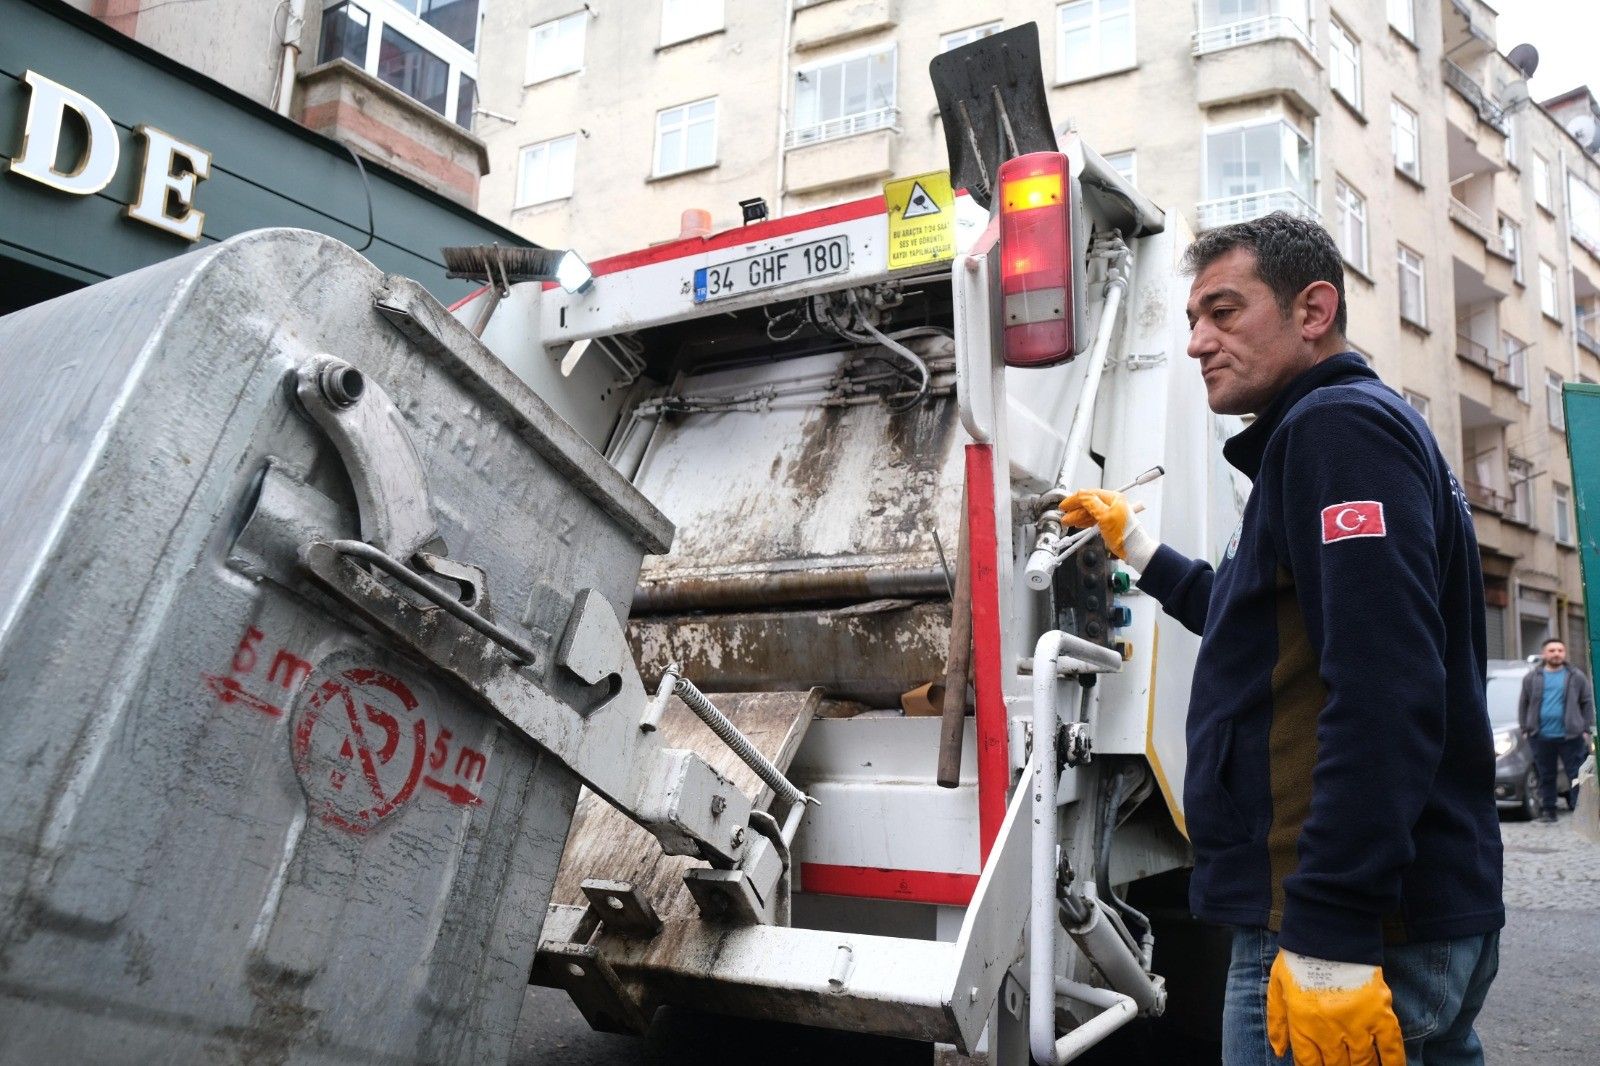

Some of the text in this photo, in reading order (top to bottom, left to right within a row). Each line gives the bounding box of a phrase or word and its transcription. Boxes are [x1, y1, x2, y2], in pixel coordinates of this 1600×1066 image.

[899, 240, 910, 249] SES
[911, 239, 918, 247] VE
[709, 266, 734, 295] 34
[749, 253, 789, 287] GHF
[803, 241, 842, 274] 180
